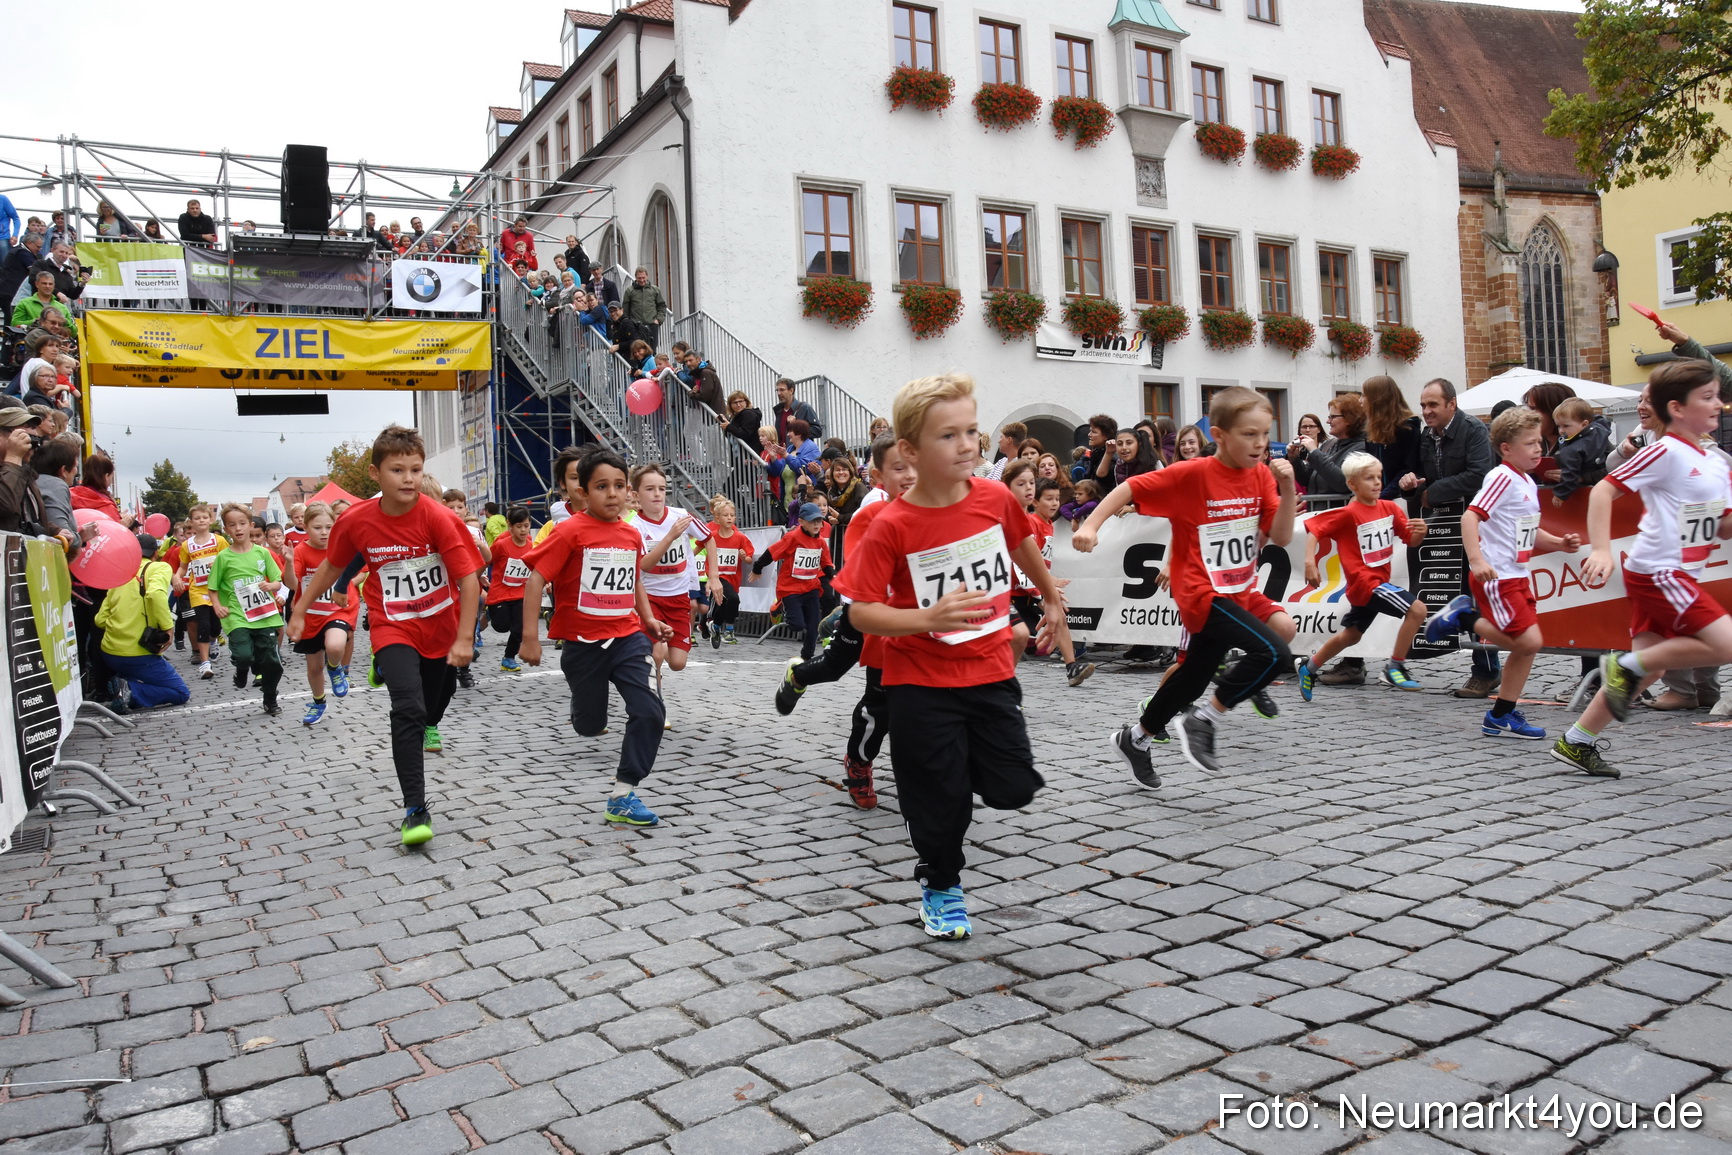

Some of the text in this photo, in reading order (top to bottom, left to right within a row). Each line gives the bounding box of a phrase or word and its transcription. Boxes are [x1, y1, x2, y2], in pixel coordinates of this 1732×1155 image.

[191, 263, 258, 280] BOCK
[266, 268, 298, 278] OFFICE
[134, 279, 180, 287] NeuerMarkt
[284, 281, 364, 293] www.bockonline.de
[110, 338, 204, 352] Neumarkter Stadtlauf
[255, 327, 345, 360] ZIEL
[1080, 332, 1128, 352] swn
[392, 347, 473, 356] Neumarkter Stadtlauf
[1080, 350, 1139, 361] stadtwerke neumarkt
[1206, 497, 1256, 508] Neumarkter
[1207, 507, 1247, 518] Stadtlauf
[1432, 506, 1450, 514] Strom
[1428, 527, 1452, 535] Erdgas
[1363, 526, 1395, 551] 711
[367, 544, 410, 554] Neumarkter
[1209, 534, 1256, 567] 706
[719, 554, 736, 565] 148
[194, 564, 212, 576] 715
[925, 551, 1010, 601] 7154
[1429, 571, 1450, 579] Wärme
[387, 565, 443, 598] 7150
[590, 566, 635, 591] 7423
[242, 590, 272, 609] 7404
[1426, 593, 1449, 601] Freizeit
[406, 597, 435, 612] Adrian
[22, 694, 44, 709] Freizeit
[25, 727, 58, 746] Stadtbusse
